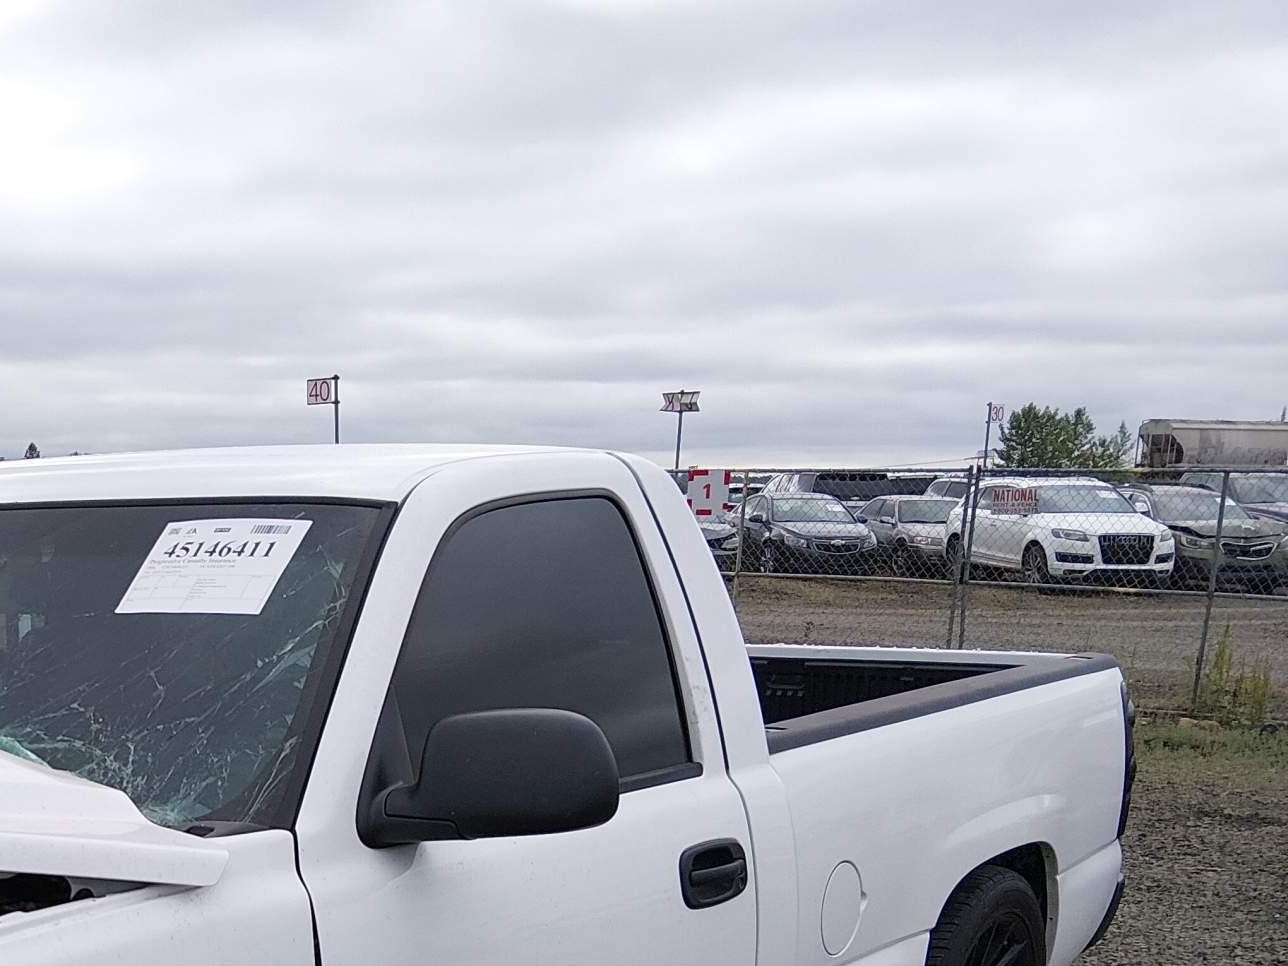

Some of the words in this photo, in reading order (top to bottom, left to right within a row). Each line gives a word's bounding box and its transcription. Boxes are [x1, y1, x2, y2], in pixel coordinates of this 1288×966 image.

[309, 381, 330, 402] 40
[991, 406, 1004, 422] 30
[703, 483, 711, 499] 1
[993, 489, 1039, 502] NATIONAL
[163, 540, 278, 558] 45146411
